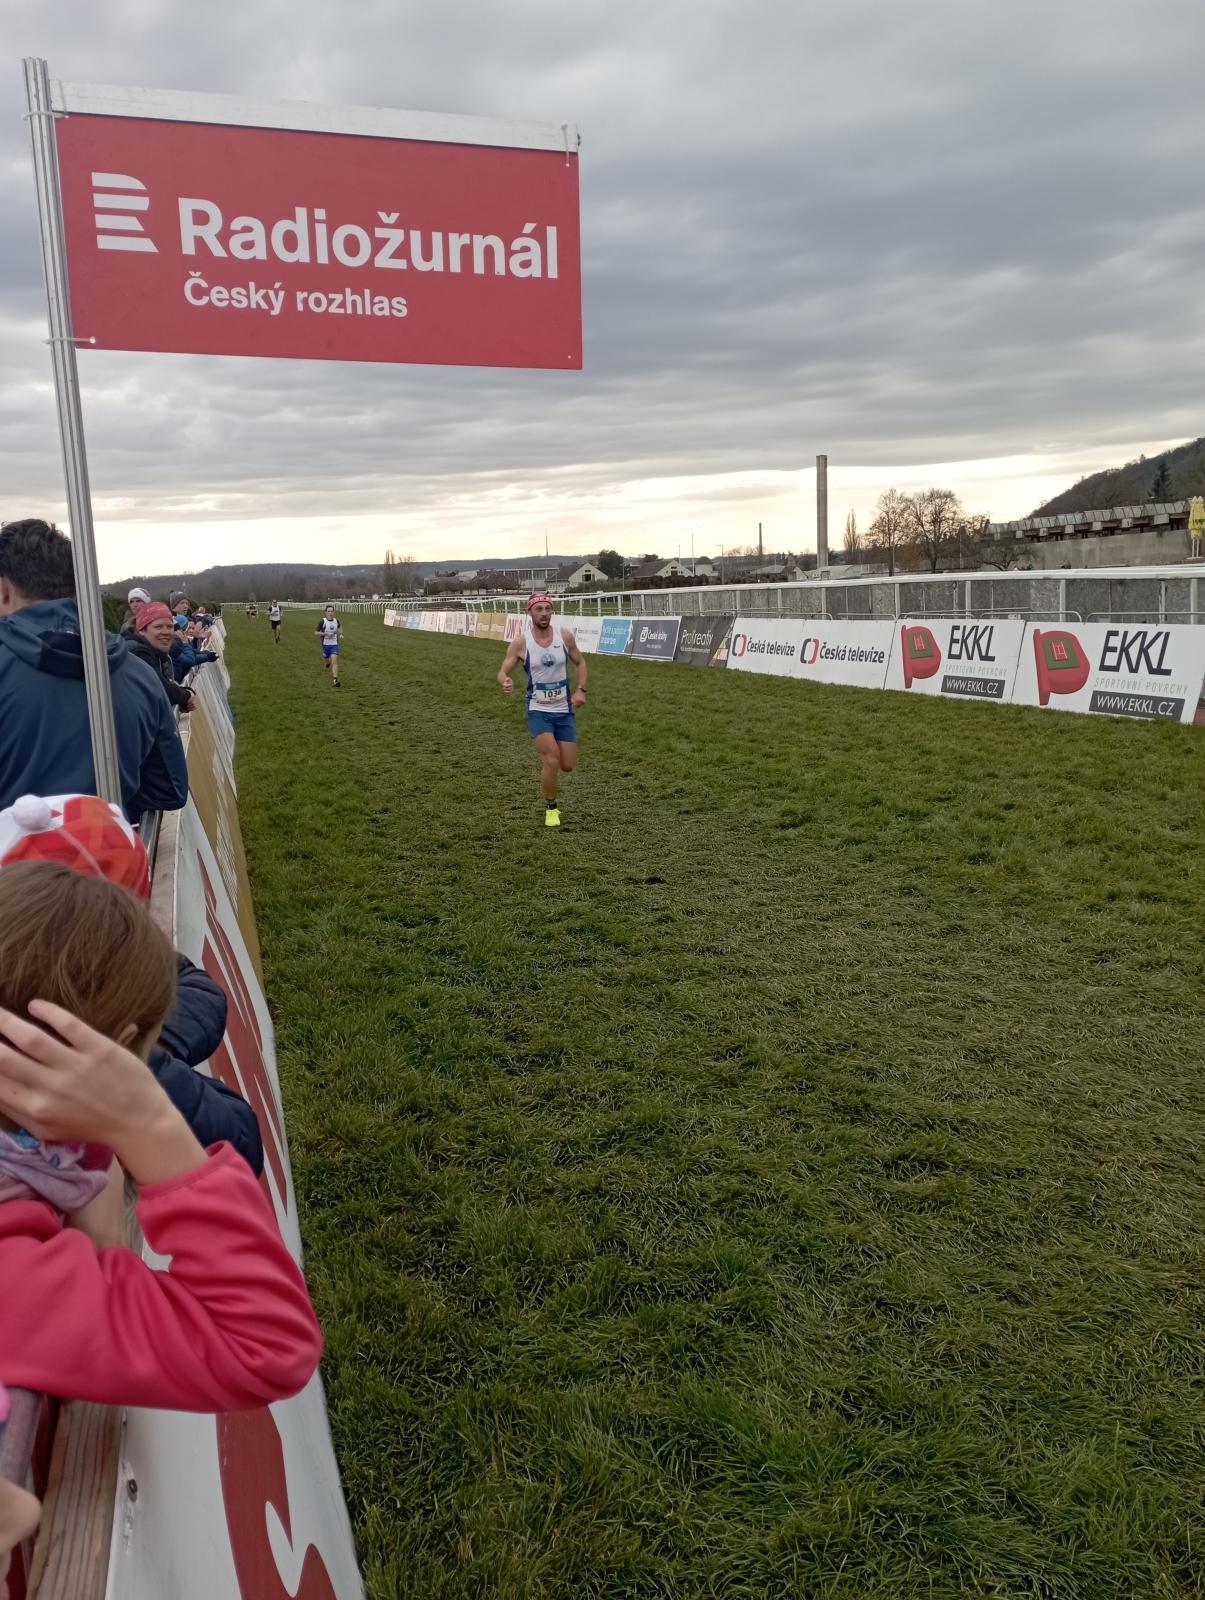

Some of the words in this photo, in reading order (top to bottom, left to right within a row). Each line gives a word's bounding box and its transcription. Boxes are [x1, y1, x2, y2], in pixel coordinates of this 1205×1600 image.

[178, 197, 558, 279] Radiožurnál
[183, 271, 285, 315] Český
[296, 287, 408, 317] rozhlas
[746, 636, 766, 653] Česká
[766, 641, 796, 657] televize
[819, 641, 847, 661] Česká
[847, 646, 885, 663] televize
[947, 625, 996, 662] EKKL
[1098, 630, 1172, 676] EKKL
[944, 663, 976, 675] SPORTOVNÍ
[978, 666, 1008, 677] POVRCHY
[946, 678, 999, 694] WWW.EKKL.CZ
[1094, 677, 1143, 690] SPORTOVNÍ
[1145, 681, 1188, 695] POVRCHY
[1097, 695, 1176, 716] WWW.EKKL.CZ
